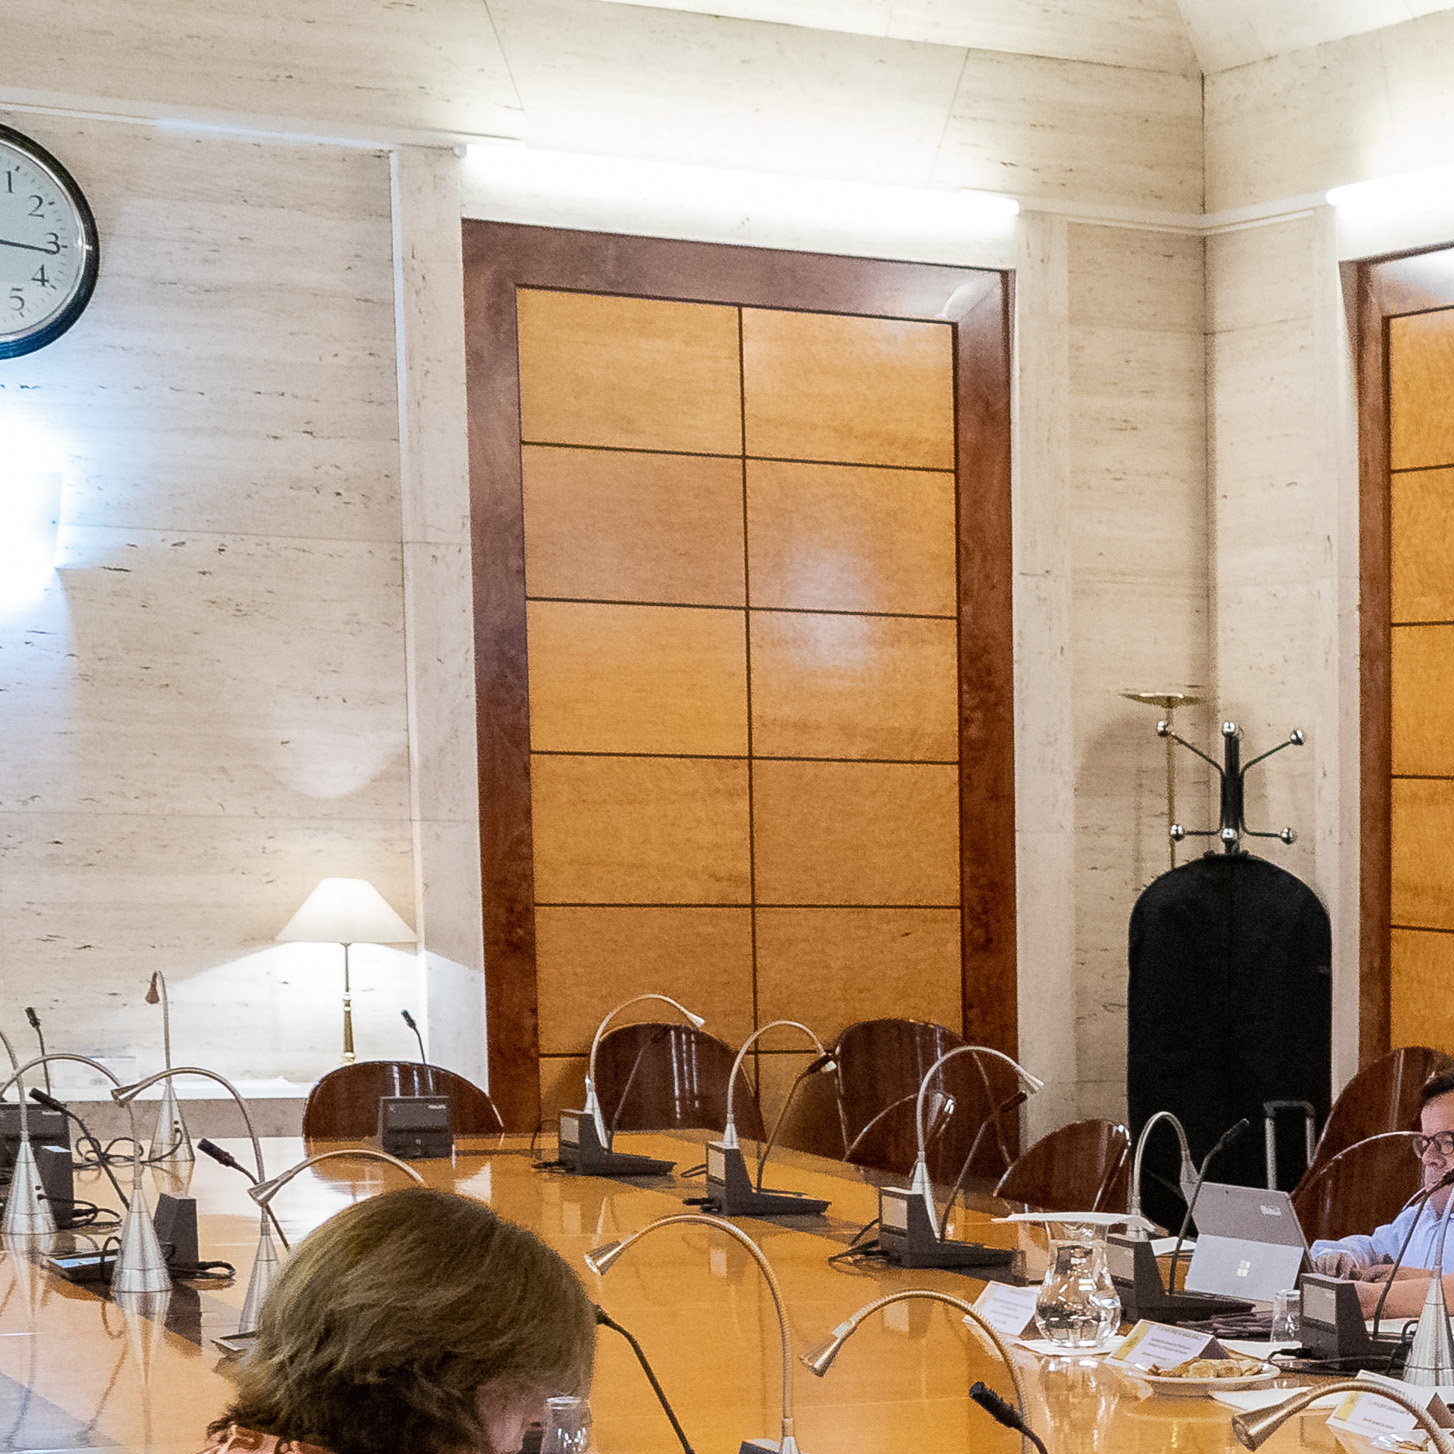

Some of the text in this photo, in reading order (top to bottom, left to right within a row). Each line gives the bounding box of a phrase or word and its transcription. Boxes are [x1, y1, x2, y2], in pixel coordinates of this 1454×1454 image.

[5, 170, 14, 193] 1
[28, 194, 45, 218] 2
[45, 232, 60, 255] 3
[31, 264, 50, 287] 4
[10, 287, 25, 311] 5
